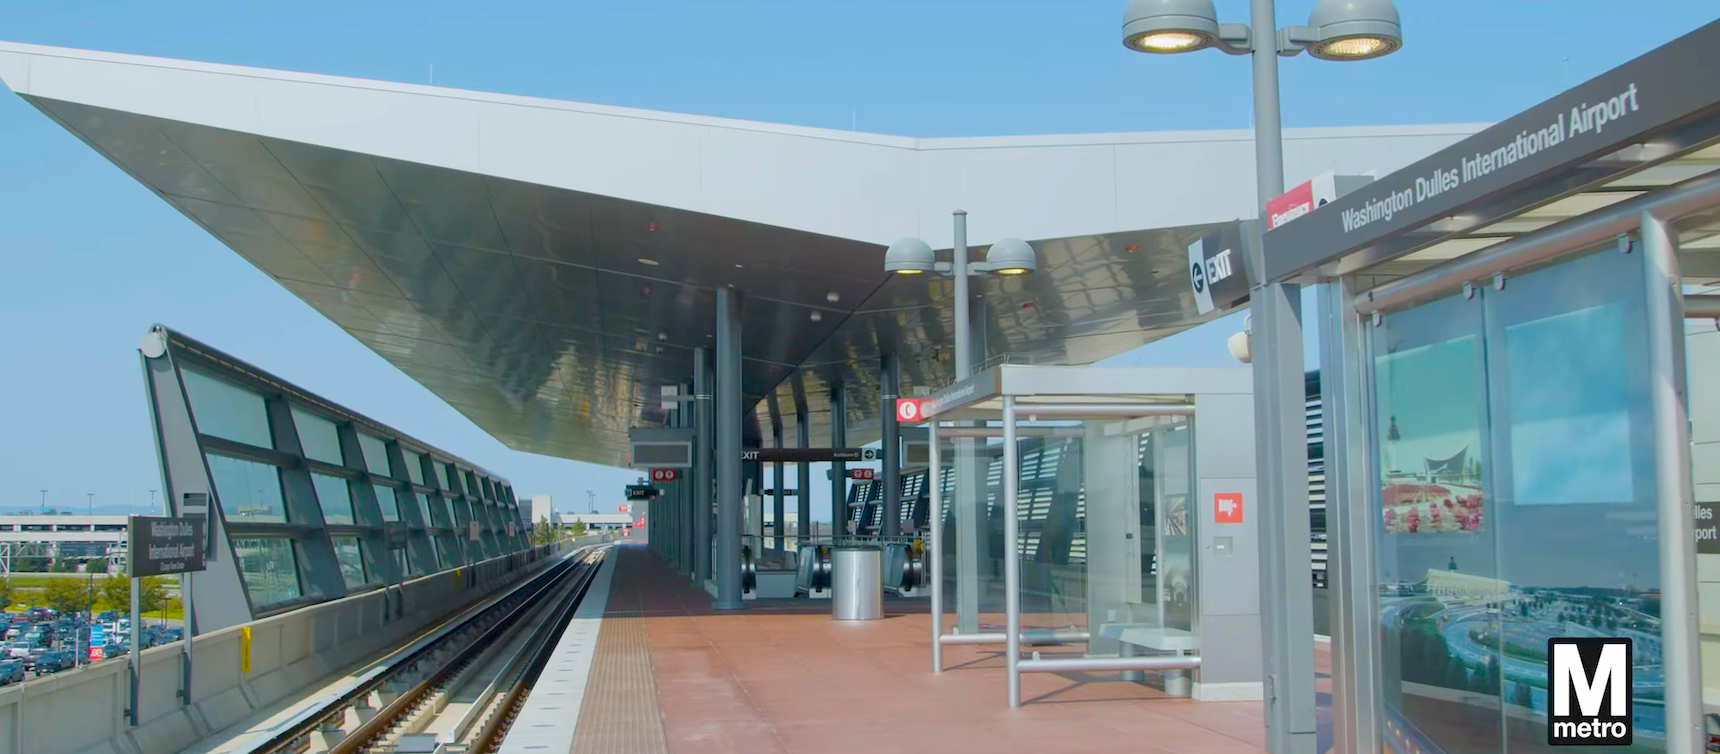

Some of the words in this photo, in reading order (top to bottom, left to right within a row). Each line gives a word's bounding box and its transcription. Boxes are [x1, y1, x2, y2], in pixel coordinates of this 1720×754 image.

[1342, 187, 1414, 233] Washington
[1415, 167, 1460, 203] Dulles
[1462, 114, 1565, 183] International
[1568, 83, 1639, 138] Airport
[1205, 248, 1232, 285] EXIT
[1692, 504, 1714, 520] lles
[151, 521, 179, 540] Washington
[179, 521, 193, 536] Dulles
[1693, 525, 1718, 543] port
[149, 543, 179, 560] International
[179, 542, 195, 561] Airport
